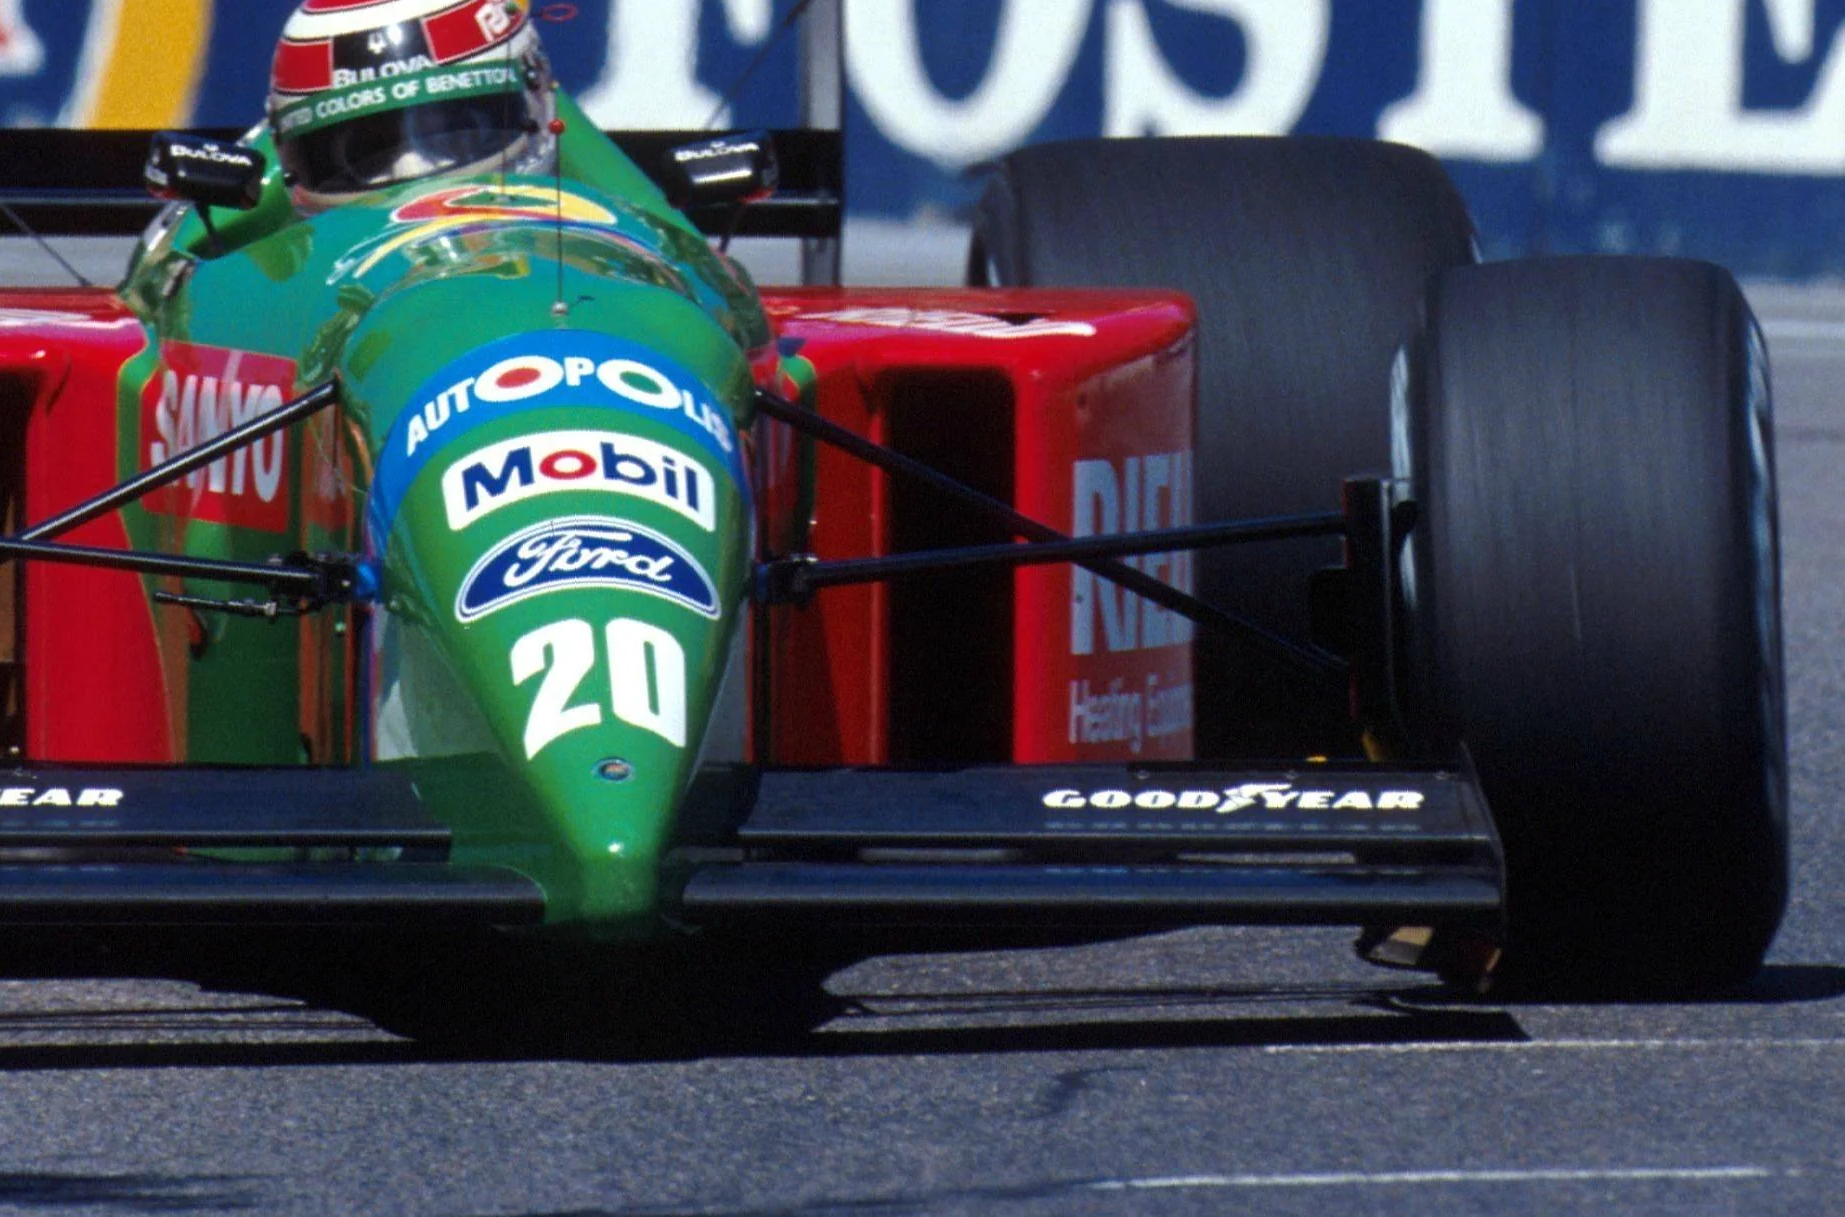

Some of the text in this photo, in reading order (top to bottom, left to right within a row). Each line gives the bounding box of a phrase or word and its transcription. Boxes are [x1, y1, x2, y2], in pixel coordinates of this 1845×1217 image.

[315, 84, 387, 119] COLORS
[391, 79, 421, 100] OF
[425, 66, 518, 95] BENETTON
[150, 369, 283, 503] SANYO
[406, 355, 732, 457] AUTOPOLIS
[461, 441, 699, 513] Mobil
[502, 528, 675, 588] Ford
[509, 617, 686, 760] 20
[1042, 783, 1425, 813] GOODYEAR
